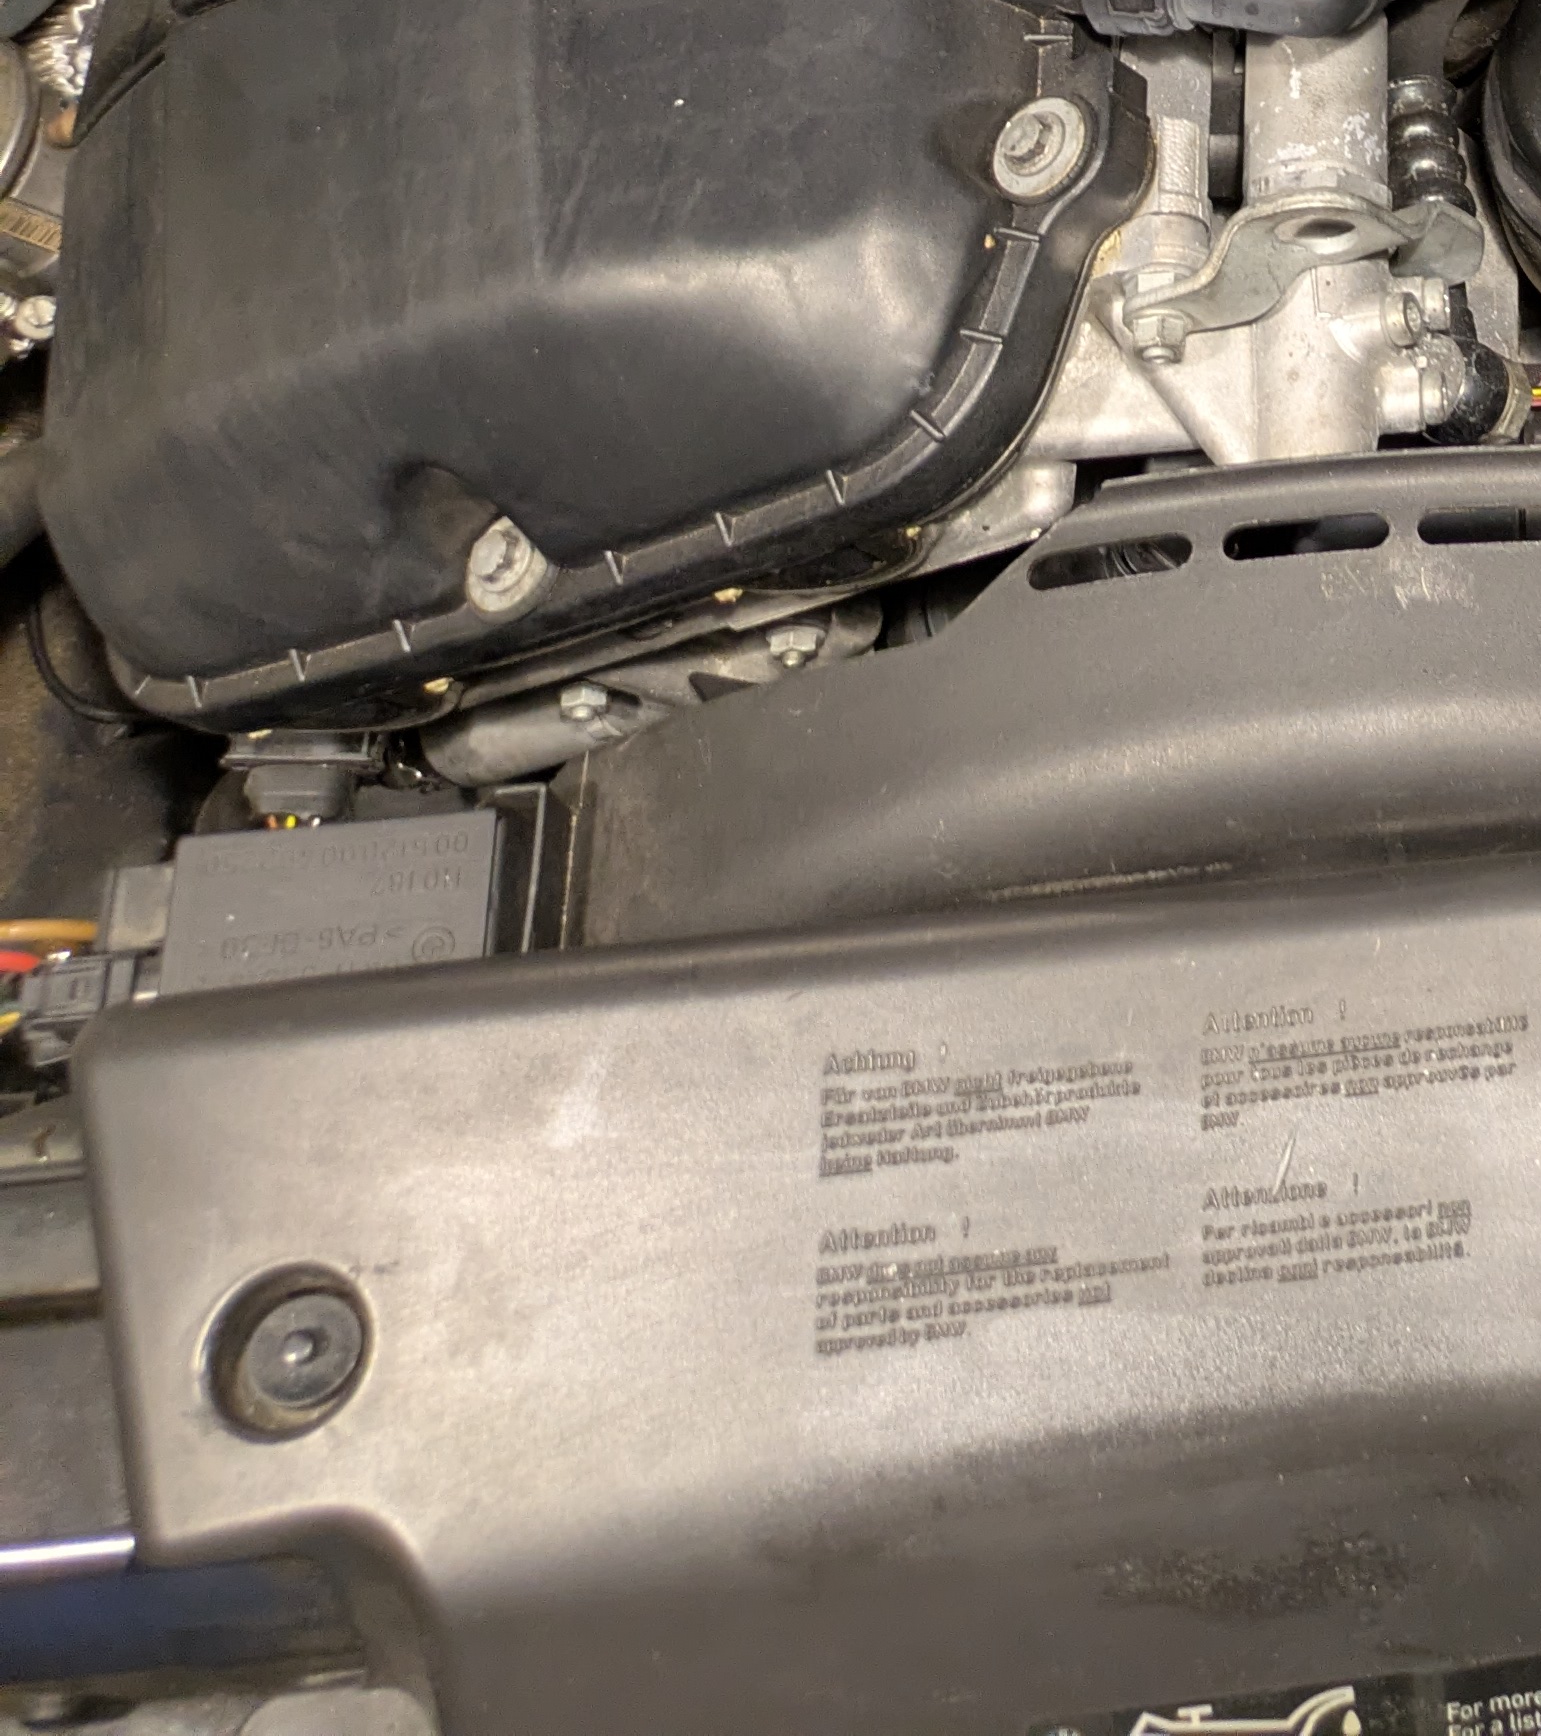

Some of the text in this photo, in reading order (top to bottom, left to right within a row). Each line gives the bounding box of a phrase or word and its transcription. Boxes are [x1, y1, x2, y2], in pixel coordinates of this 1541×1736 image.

[1202, 1005, 1314, 1035] Attention
[819, 1220, 936, 1254] Attention
[1446, 1700, 1482, 1722] For
[1490, 1717, 1503, 1734] a
[1509, 1707, 1541, 1733] list
